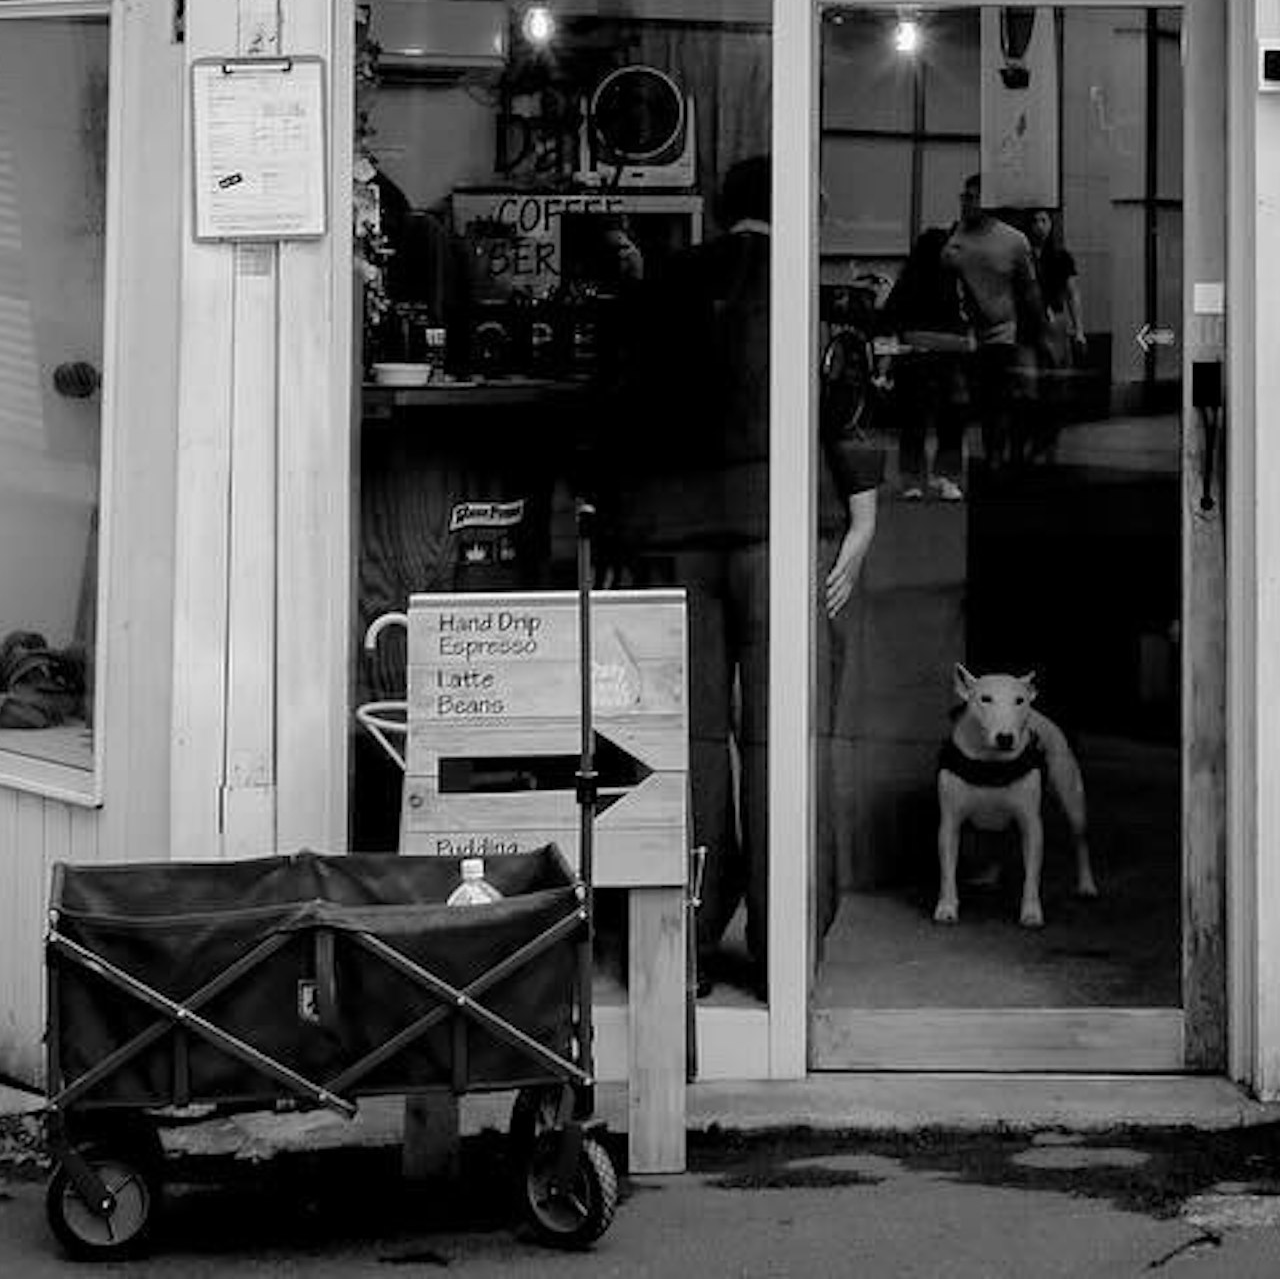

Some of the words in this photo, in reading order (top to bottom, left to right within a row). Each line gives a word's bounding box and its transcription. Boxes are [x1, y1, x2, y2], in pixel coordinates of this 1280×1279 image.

[439, 611, 493, 633] Hand
[498, 611, 542, 638] Drip
[439, 636, 538, 663] Espresso
[436, 669, 495, 689] Latte
[437, 694, 505, 715] Beans
